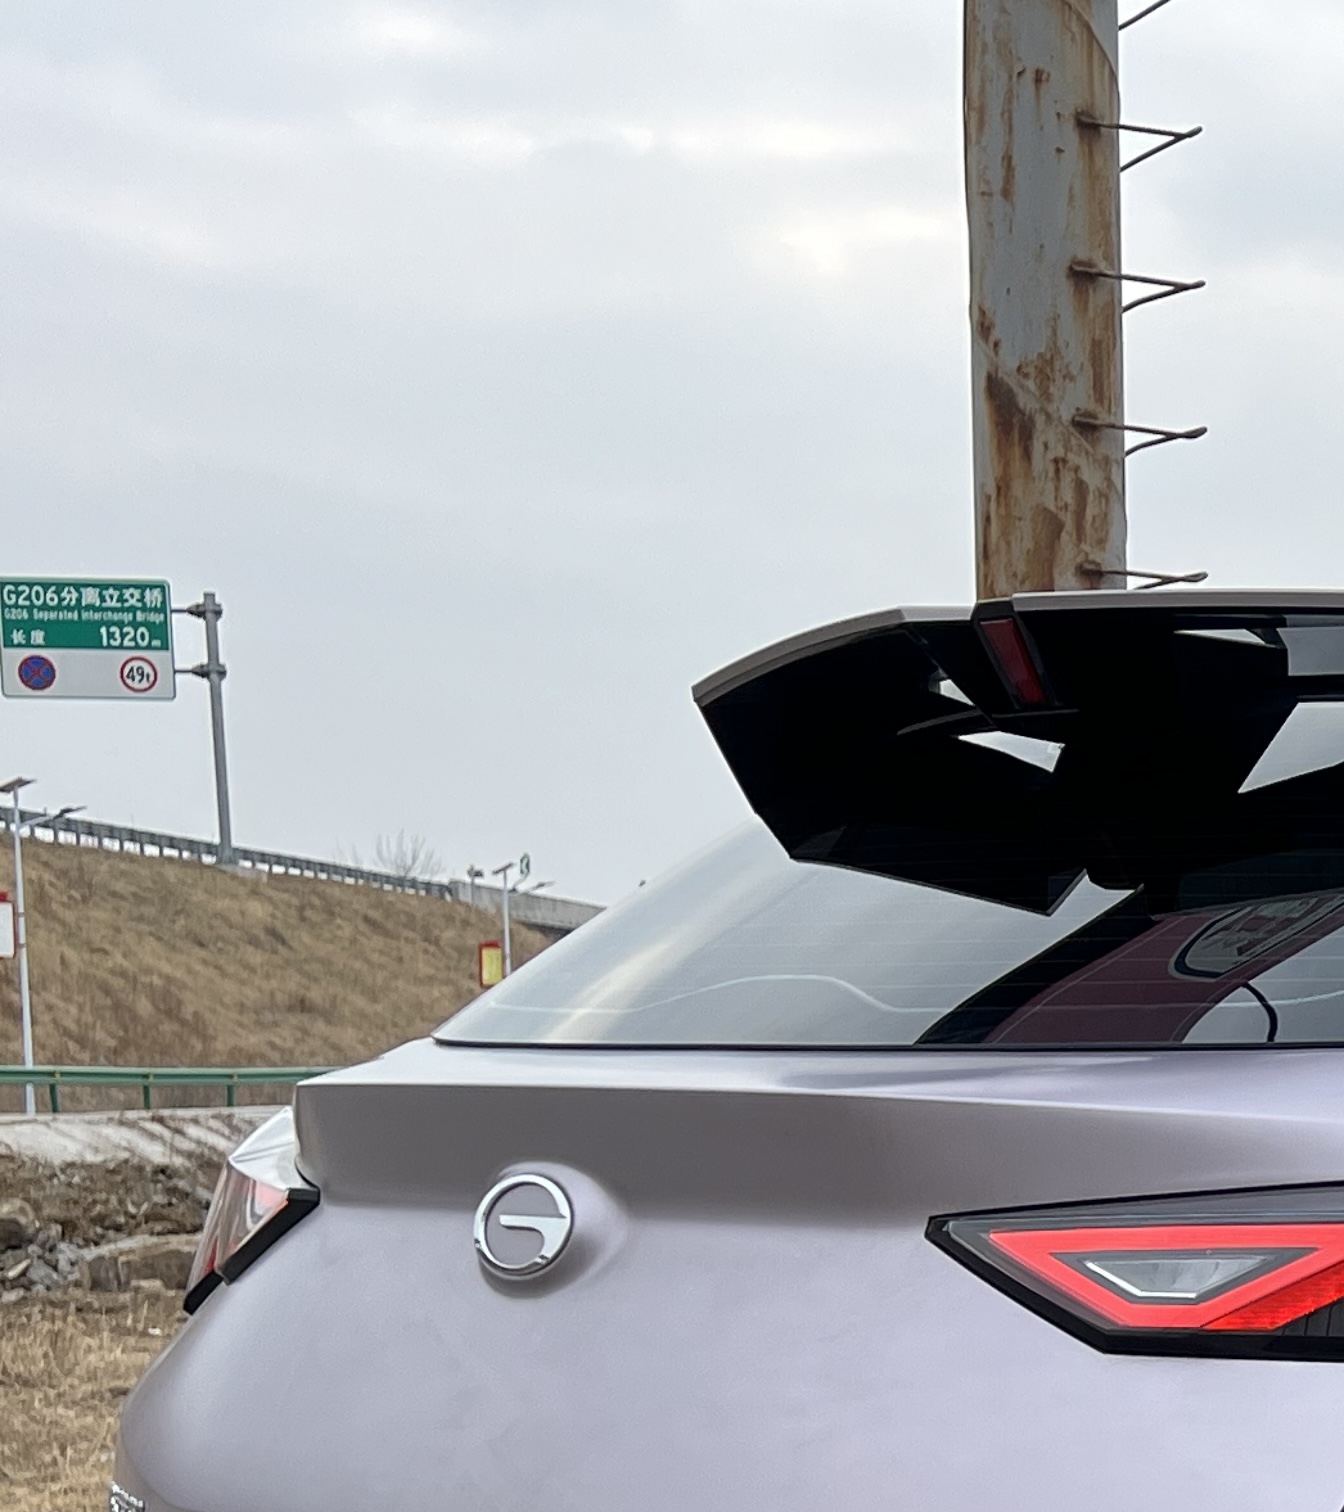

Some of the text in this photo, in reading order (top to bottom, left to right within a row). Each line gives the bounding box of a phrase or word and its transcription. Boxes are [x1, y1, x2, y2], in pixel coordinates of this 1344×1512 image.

[3, 584, 163, 608] G206分离立交桥
[4, 608, 28, 619] G206
